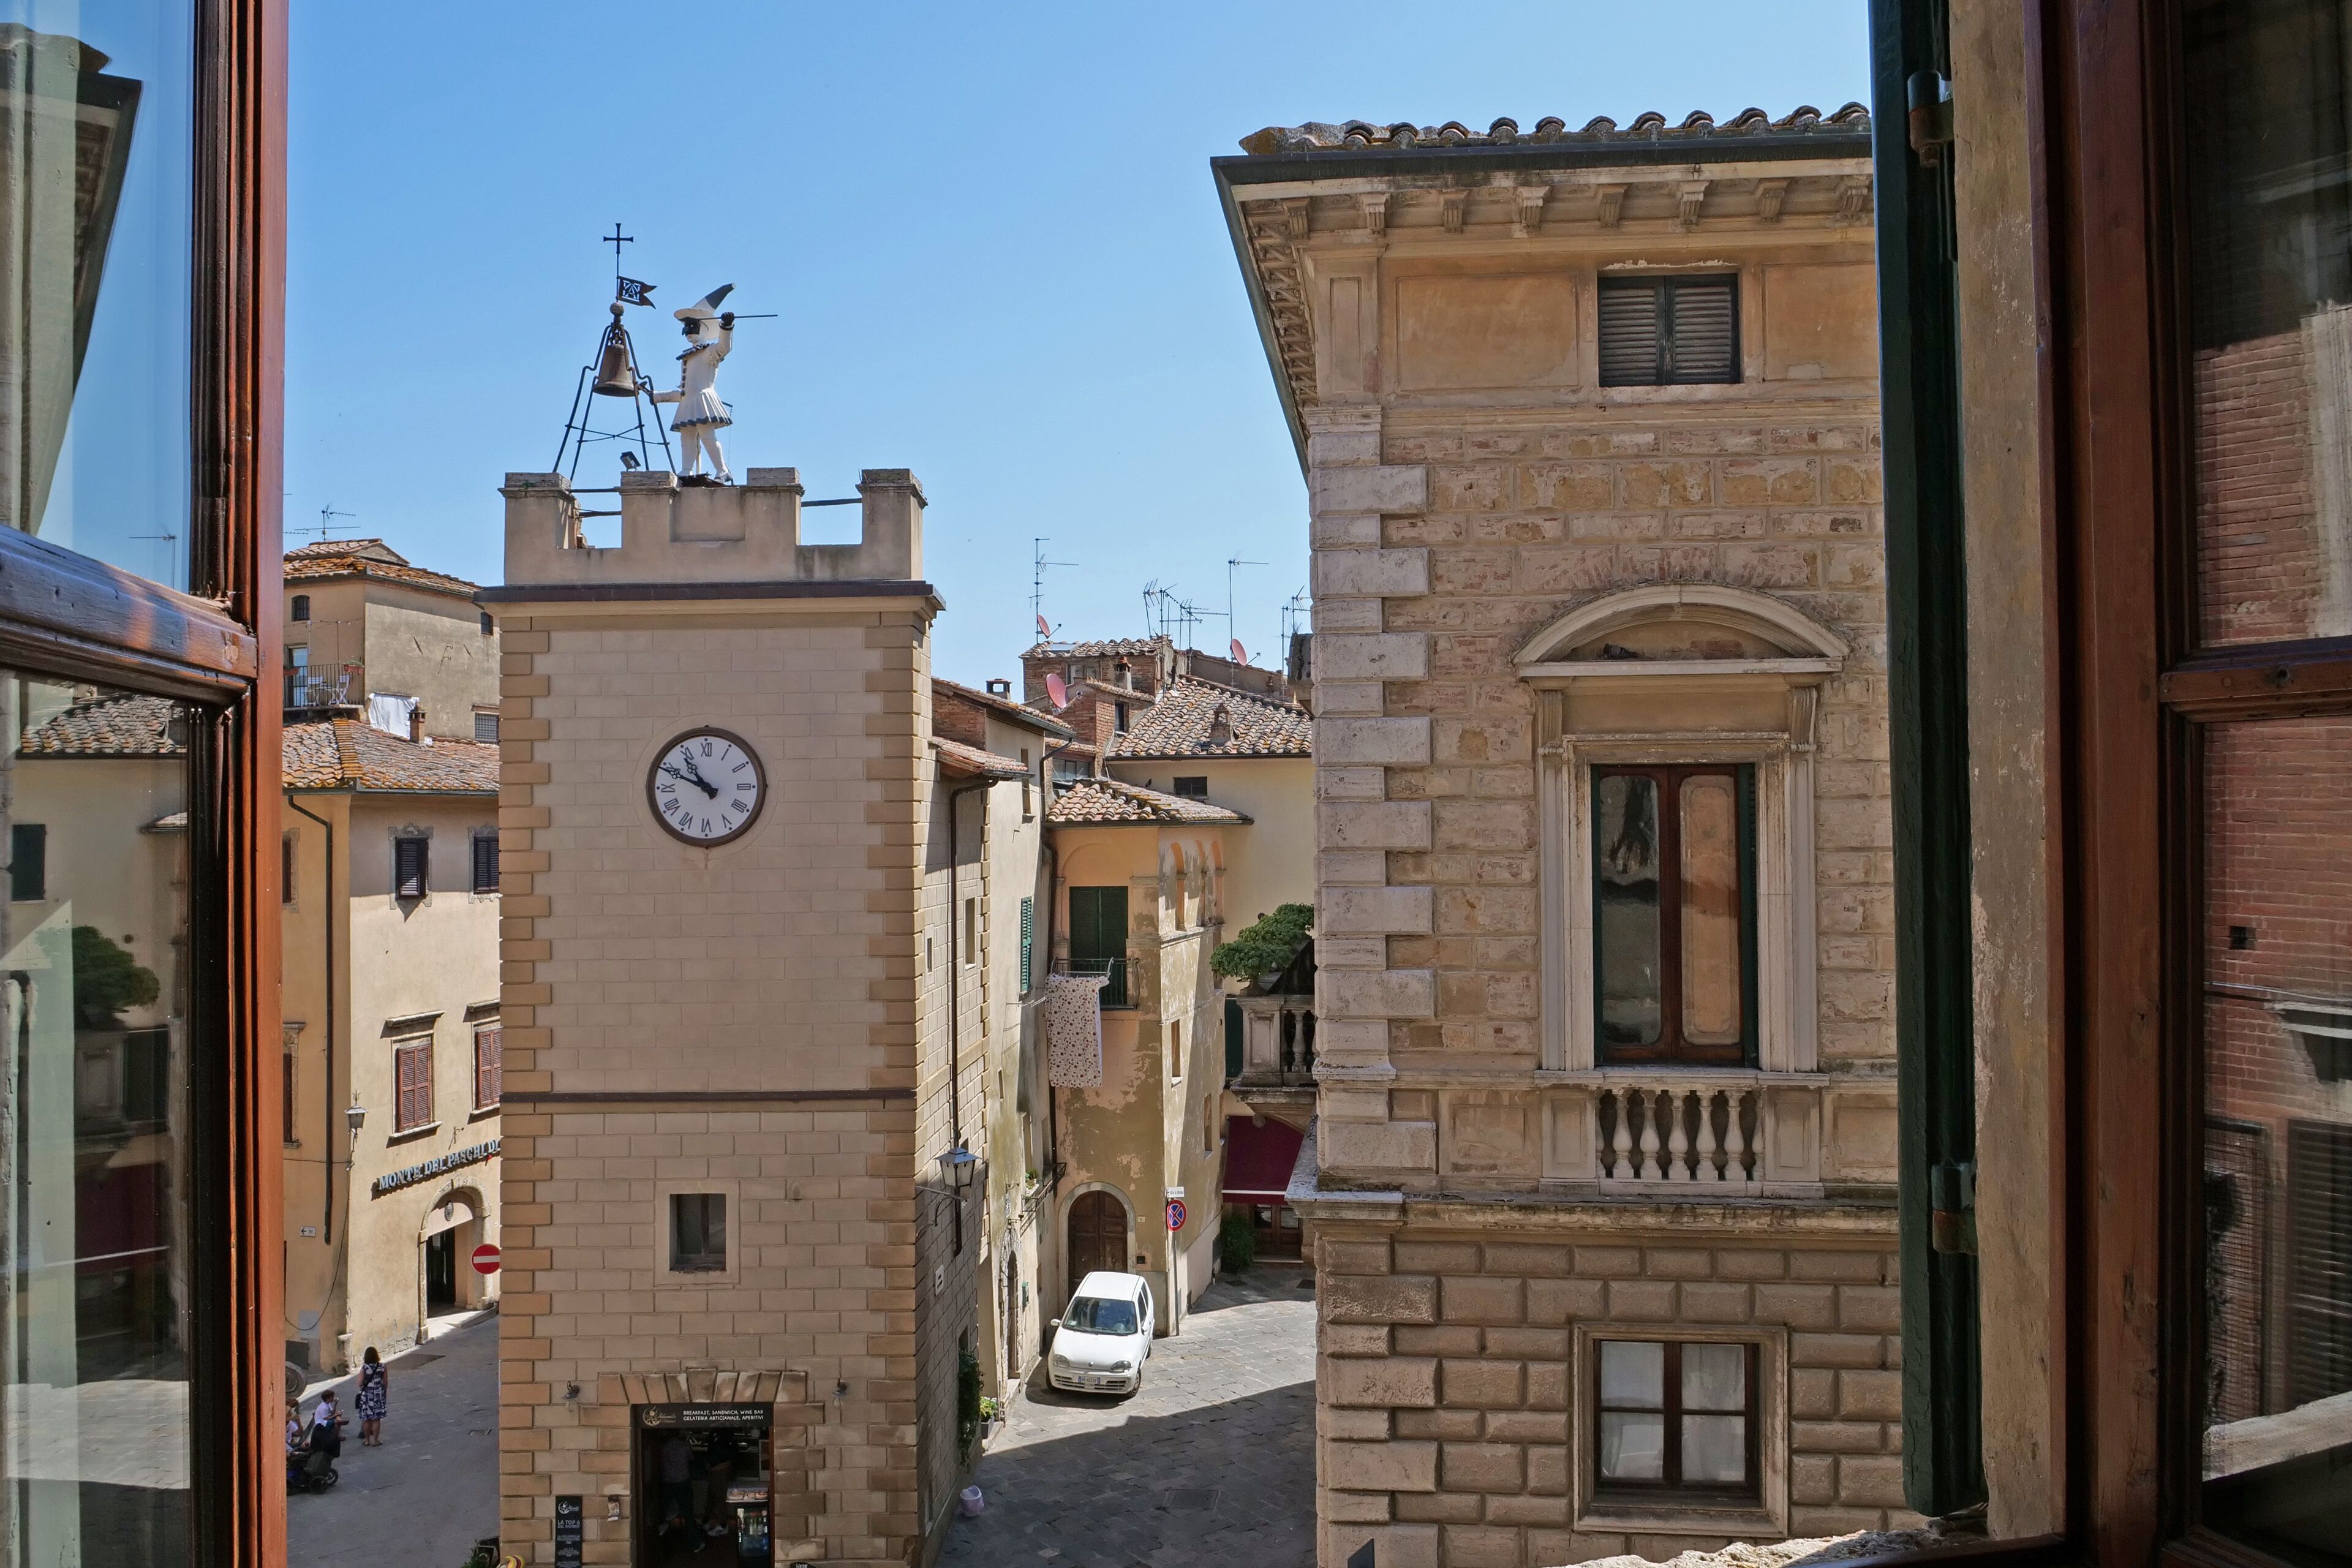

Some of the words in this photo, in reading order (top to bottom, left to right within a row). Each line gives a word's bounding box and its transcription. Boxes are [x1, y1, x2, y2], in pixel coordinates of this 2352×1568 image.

[700, 742, 712, 757] XII
[661, 783, 676, 793] IX
[379, 1166, 423, 1190] MONTE
[447, 1144, 487, 1167] PASCHI
